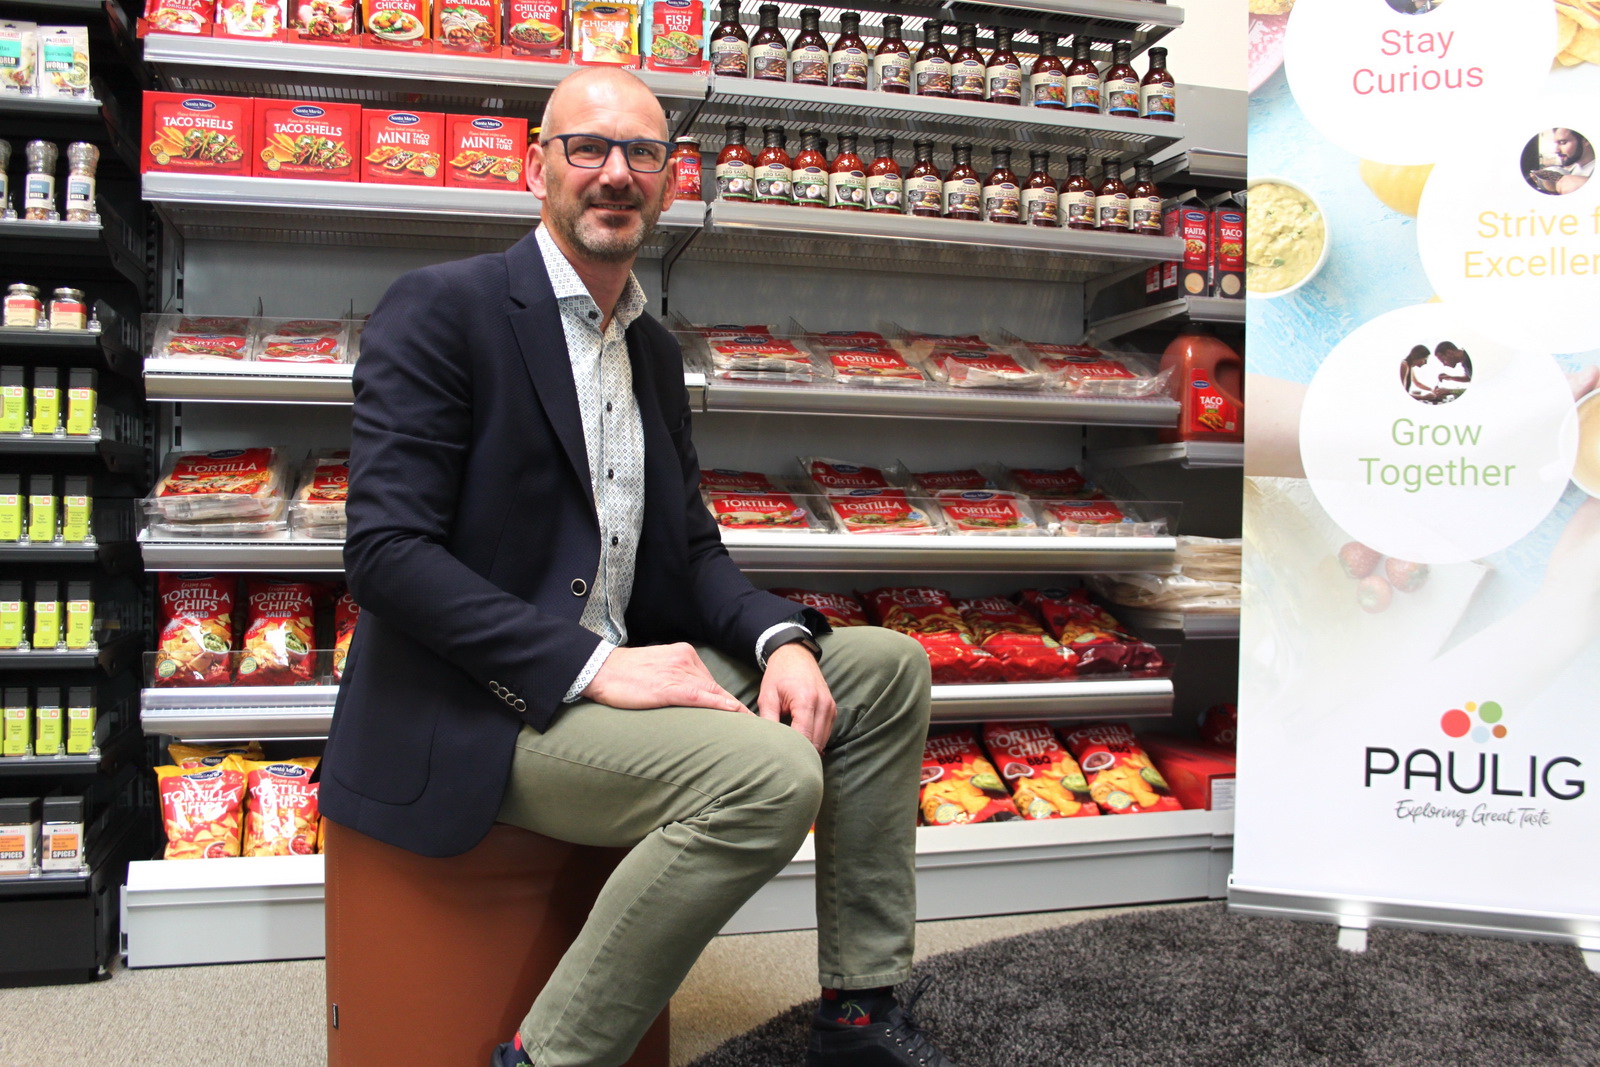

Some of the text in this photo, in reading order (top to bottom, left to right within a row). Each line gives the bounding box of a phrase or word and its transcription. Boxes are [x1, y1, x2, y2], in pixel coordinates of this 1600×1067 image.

[375, 2, 416, 11] CHICKEN
[514, 4, 558, 14] CHILI CON
[521, 12, 550, 20] CARNE
[665, 15, 692, 26] FISH
[582, 20, 629, 28] CHICKEN
[668, 24, 689, 32] TACO
[1380, 29, 1454, 60] Stay
[1352, 66, 1484, 95] Curious
[163, 117, 234, 130] TACO SHELLS
[274, 124, 342, 136] TACO SHELLS
[377, 132, 410, 144] MINI
[461, 137, 494, 148] MINI
[680, 168, 699, 176] SALSA
[1477, 208, 1579, 239] Strive
[1184, 227, 1206, 236] FAJITA
[1221, 228, 1243, 237] TACO
[836, 354, 899, 365] TORTILLA
[1200, 396, 1223, 405] TACO
[1391, 418, 1482, 446] Grow
[187, 463, 257, 473] TORTILLA
[820, 475, 879, 485] TORTILLA
[1358, 457, 1516, 493] Together
[722, 500, 787, 508] TORTILLA
[840, 501, 902, 511] TORTILLA
[952, 506, 1013, 514] TORTILLA
[162, 588, 230, 605] TORTILLA
[249, 592, 313, 606] TORTILLA
[174, 600, 218, 611] CHIPS
[258, 602, 301, 612] CHIPS
[988, 727, 1055, 748] TORTILL
[1066, 725, 1132, 745] TORTILL
[1089, 734, 1136, 746] CHIPS
[922, 745, 970, 760] CHIPS
[1008, 738, 1059, 758] CHIPS
[1108, 744, 1131, 754] BBQ
[937, 756, 963, 765] BBQ
[1026, 756, 1051, 766] BBQ
[1364, 746, 1585, 800] PAULIG
[163, 790, 238, 804] TORTILLA
[250, 784, 318, 799] TORTILLA
[261, 795, 306, 808] CHIPS
[1394, 799, 1553, 828] Exploring Great Taste
[53, 850, 76, 858] SPICES
